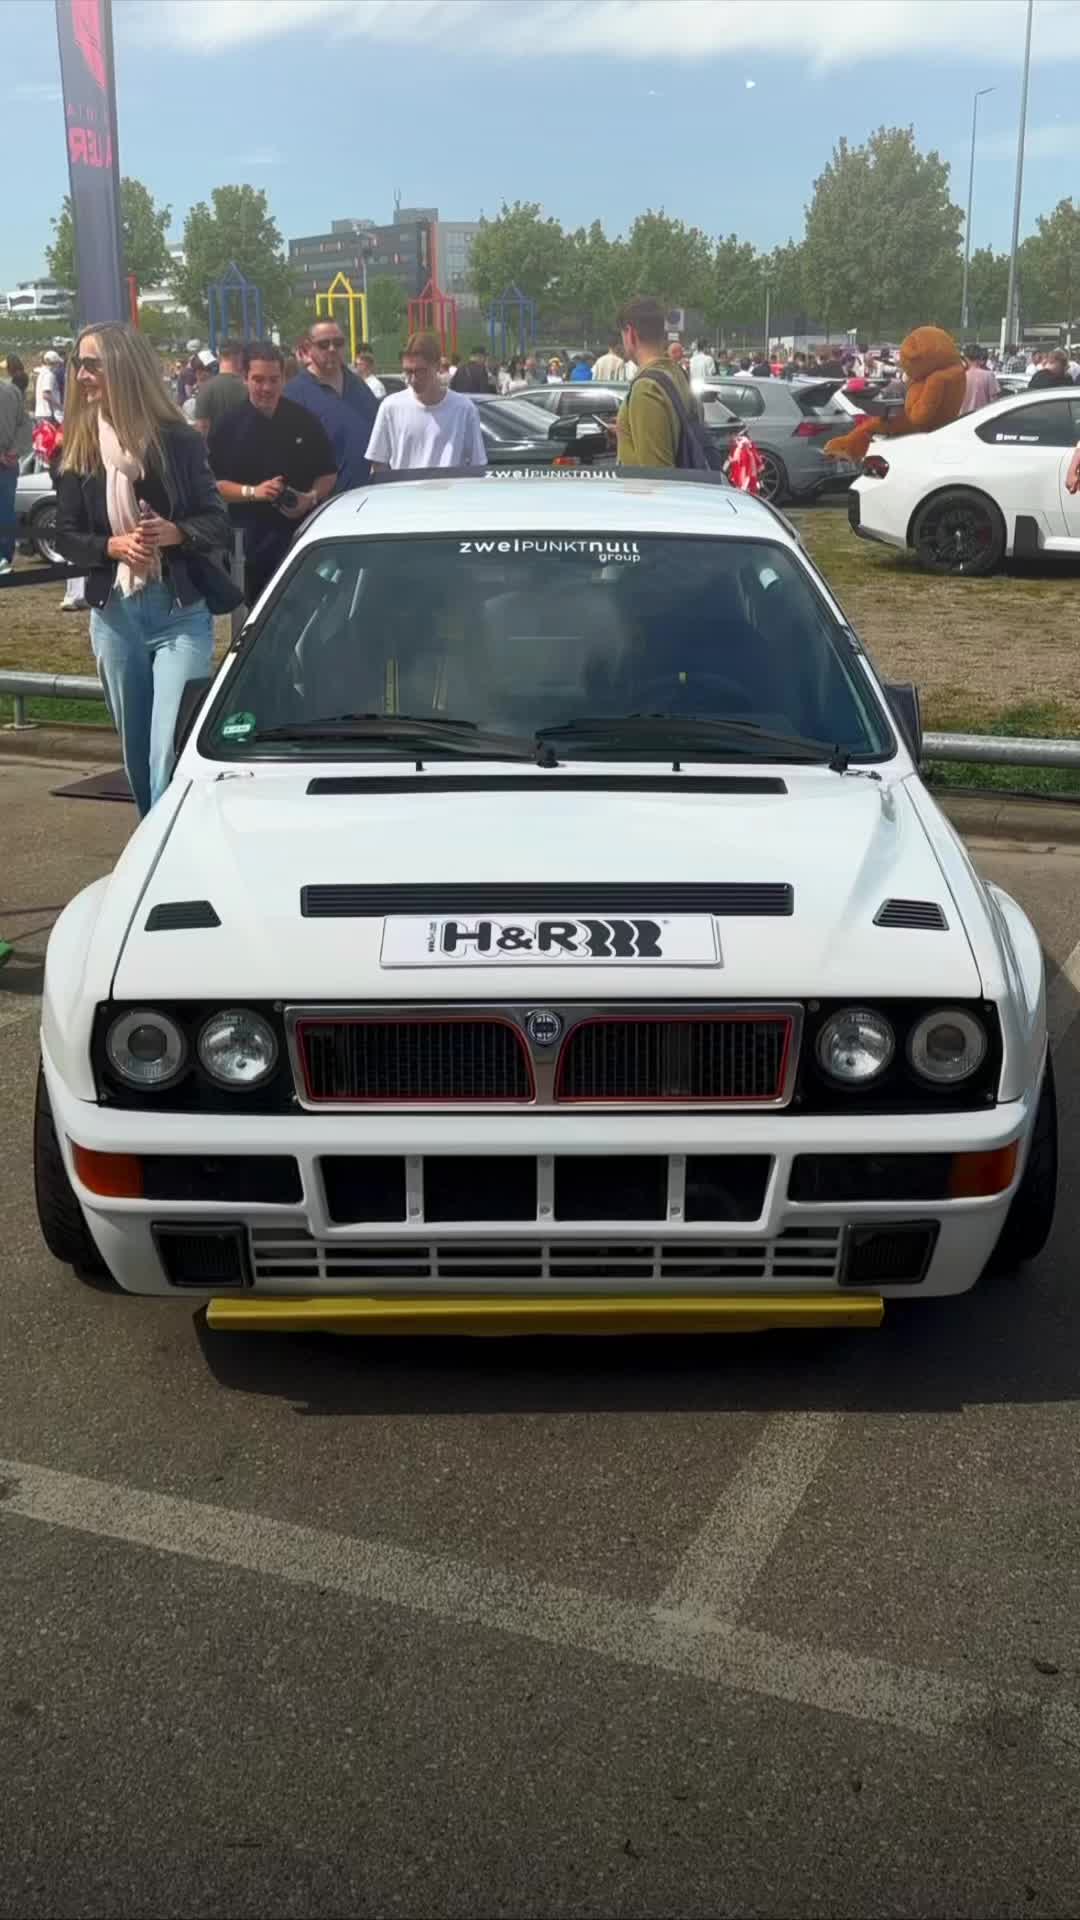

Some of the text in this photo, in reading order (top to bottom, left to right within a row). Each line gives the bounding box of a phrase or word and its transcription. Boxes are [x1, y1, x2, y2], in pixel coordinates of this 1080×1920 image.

[459, 539, 639, 553] zweiPUNKTnull
[598, 553, 641, 562] group
[441, 920, 587, 956] H&R
